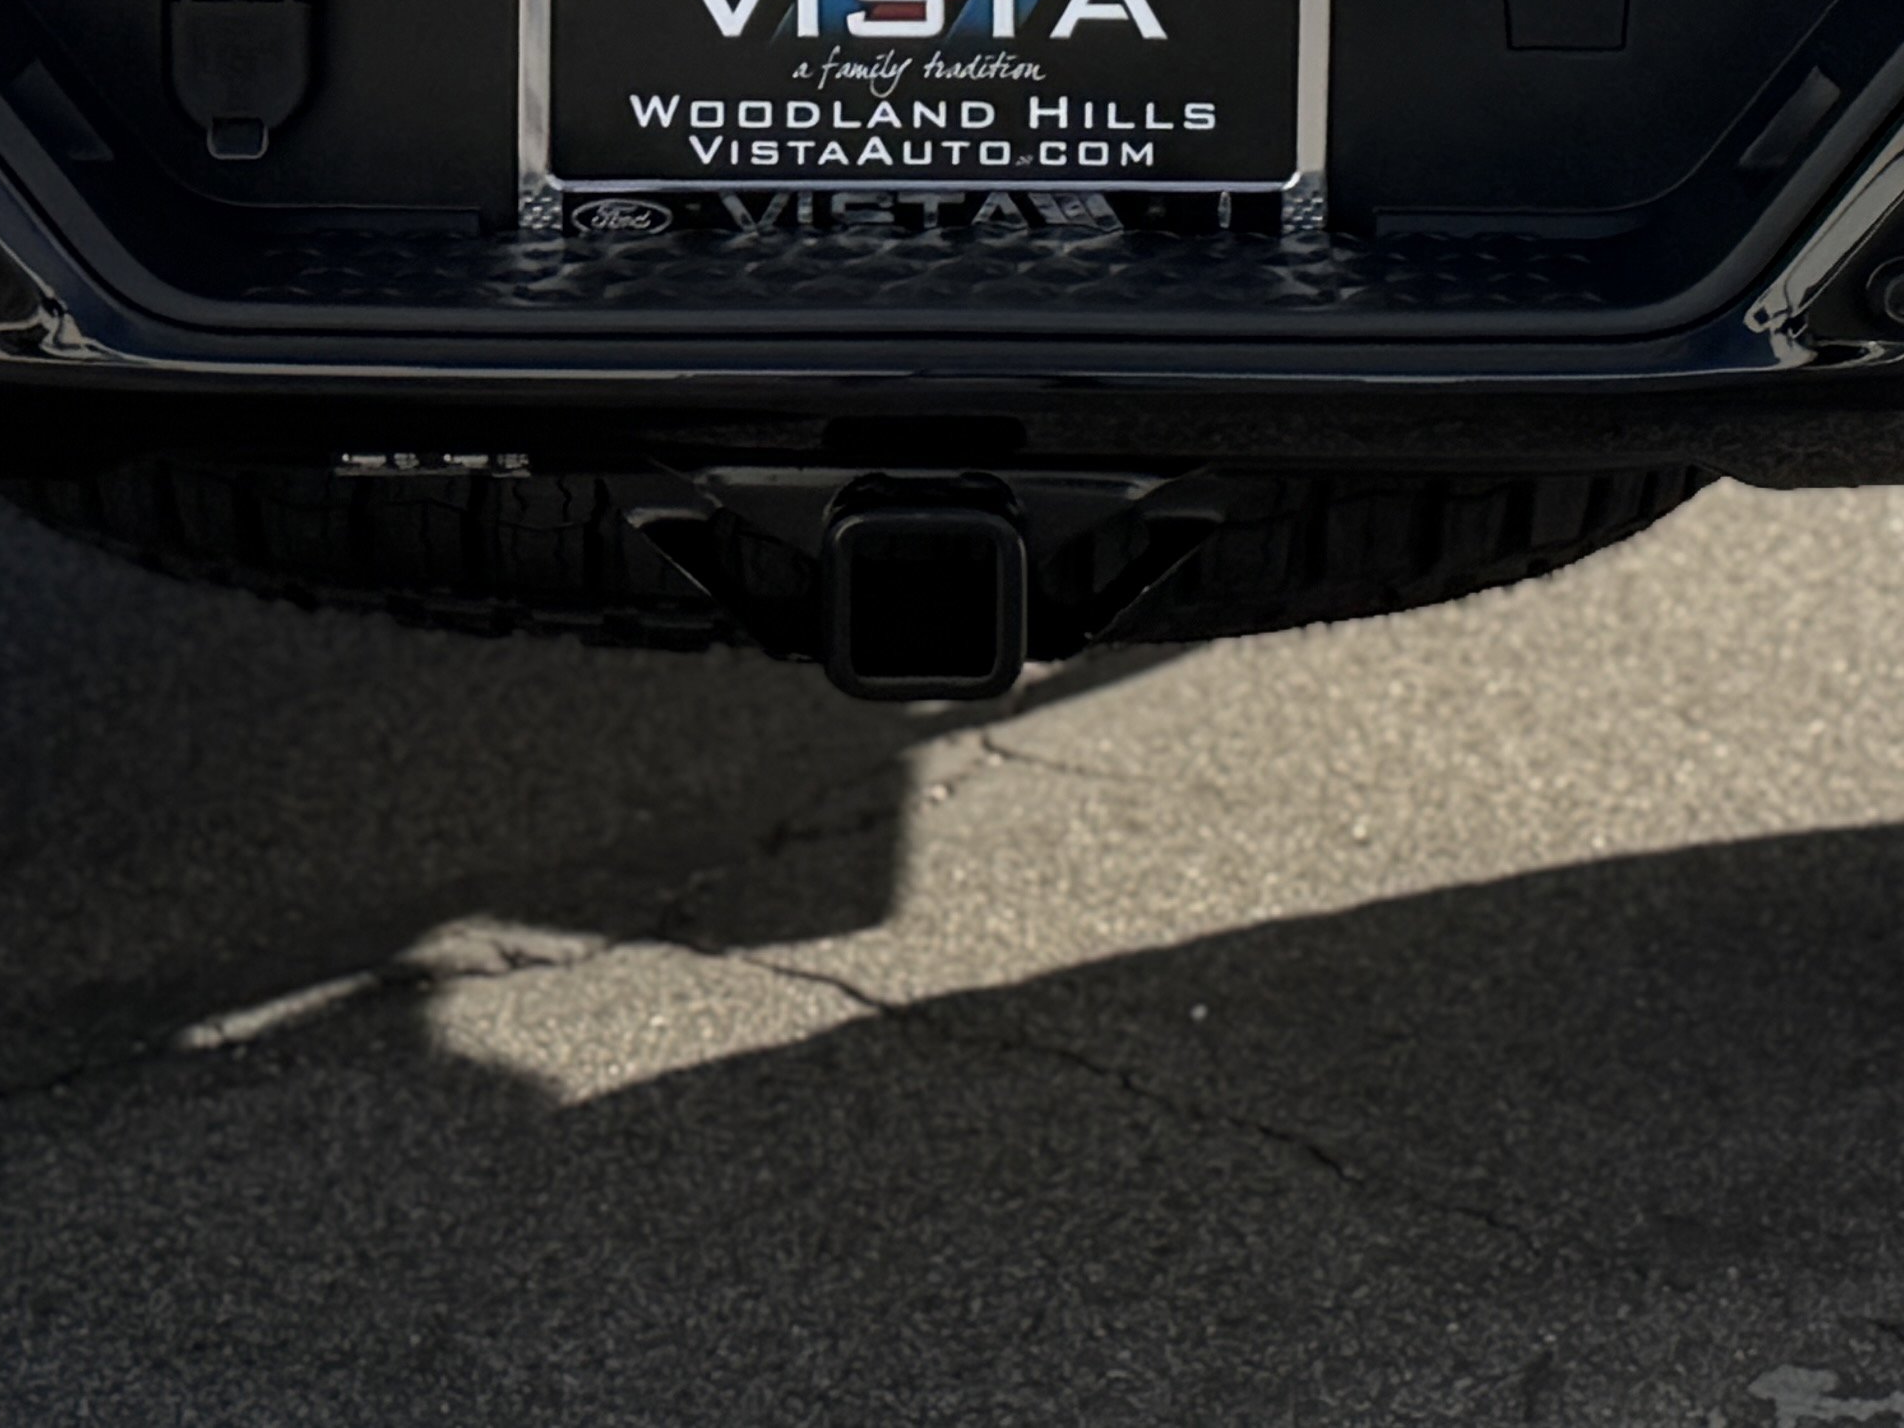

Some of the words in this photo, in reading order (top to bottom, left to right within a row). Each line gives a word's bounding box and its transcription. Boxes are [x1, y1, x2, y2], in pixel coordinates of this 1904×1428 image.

[792, 61, 813, 80] a
[817, 44, 914, 98] family
[923, 49, 1047, 81] tradition
